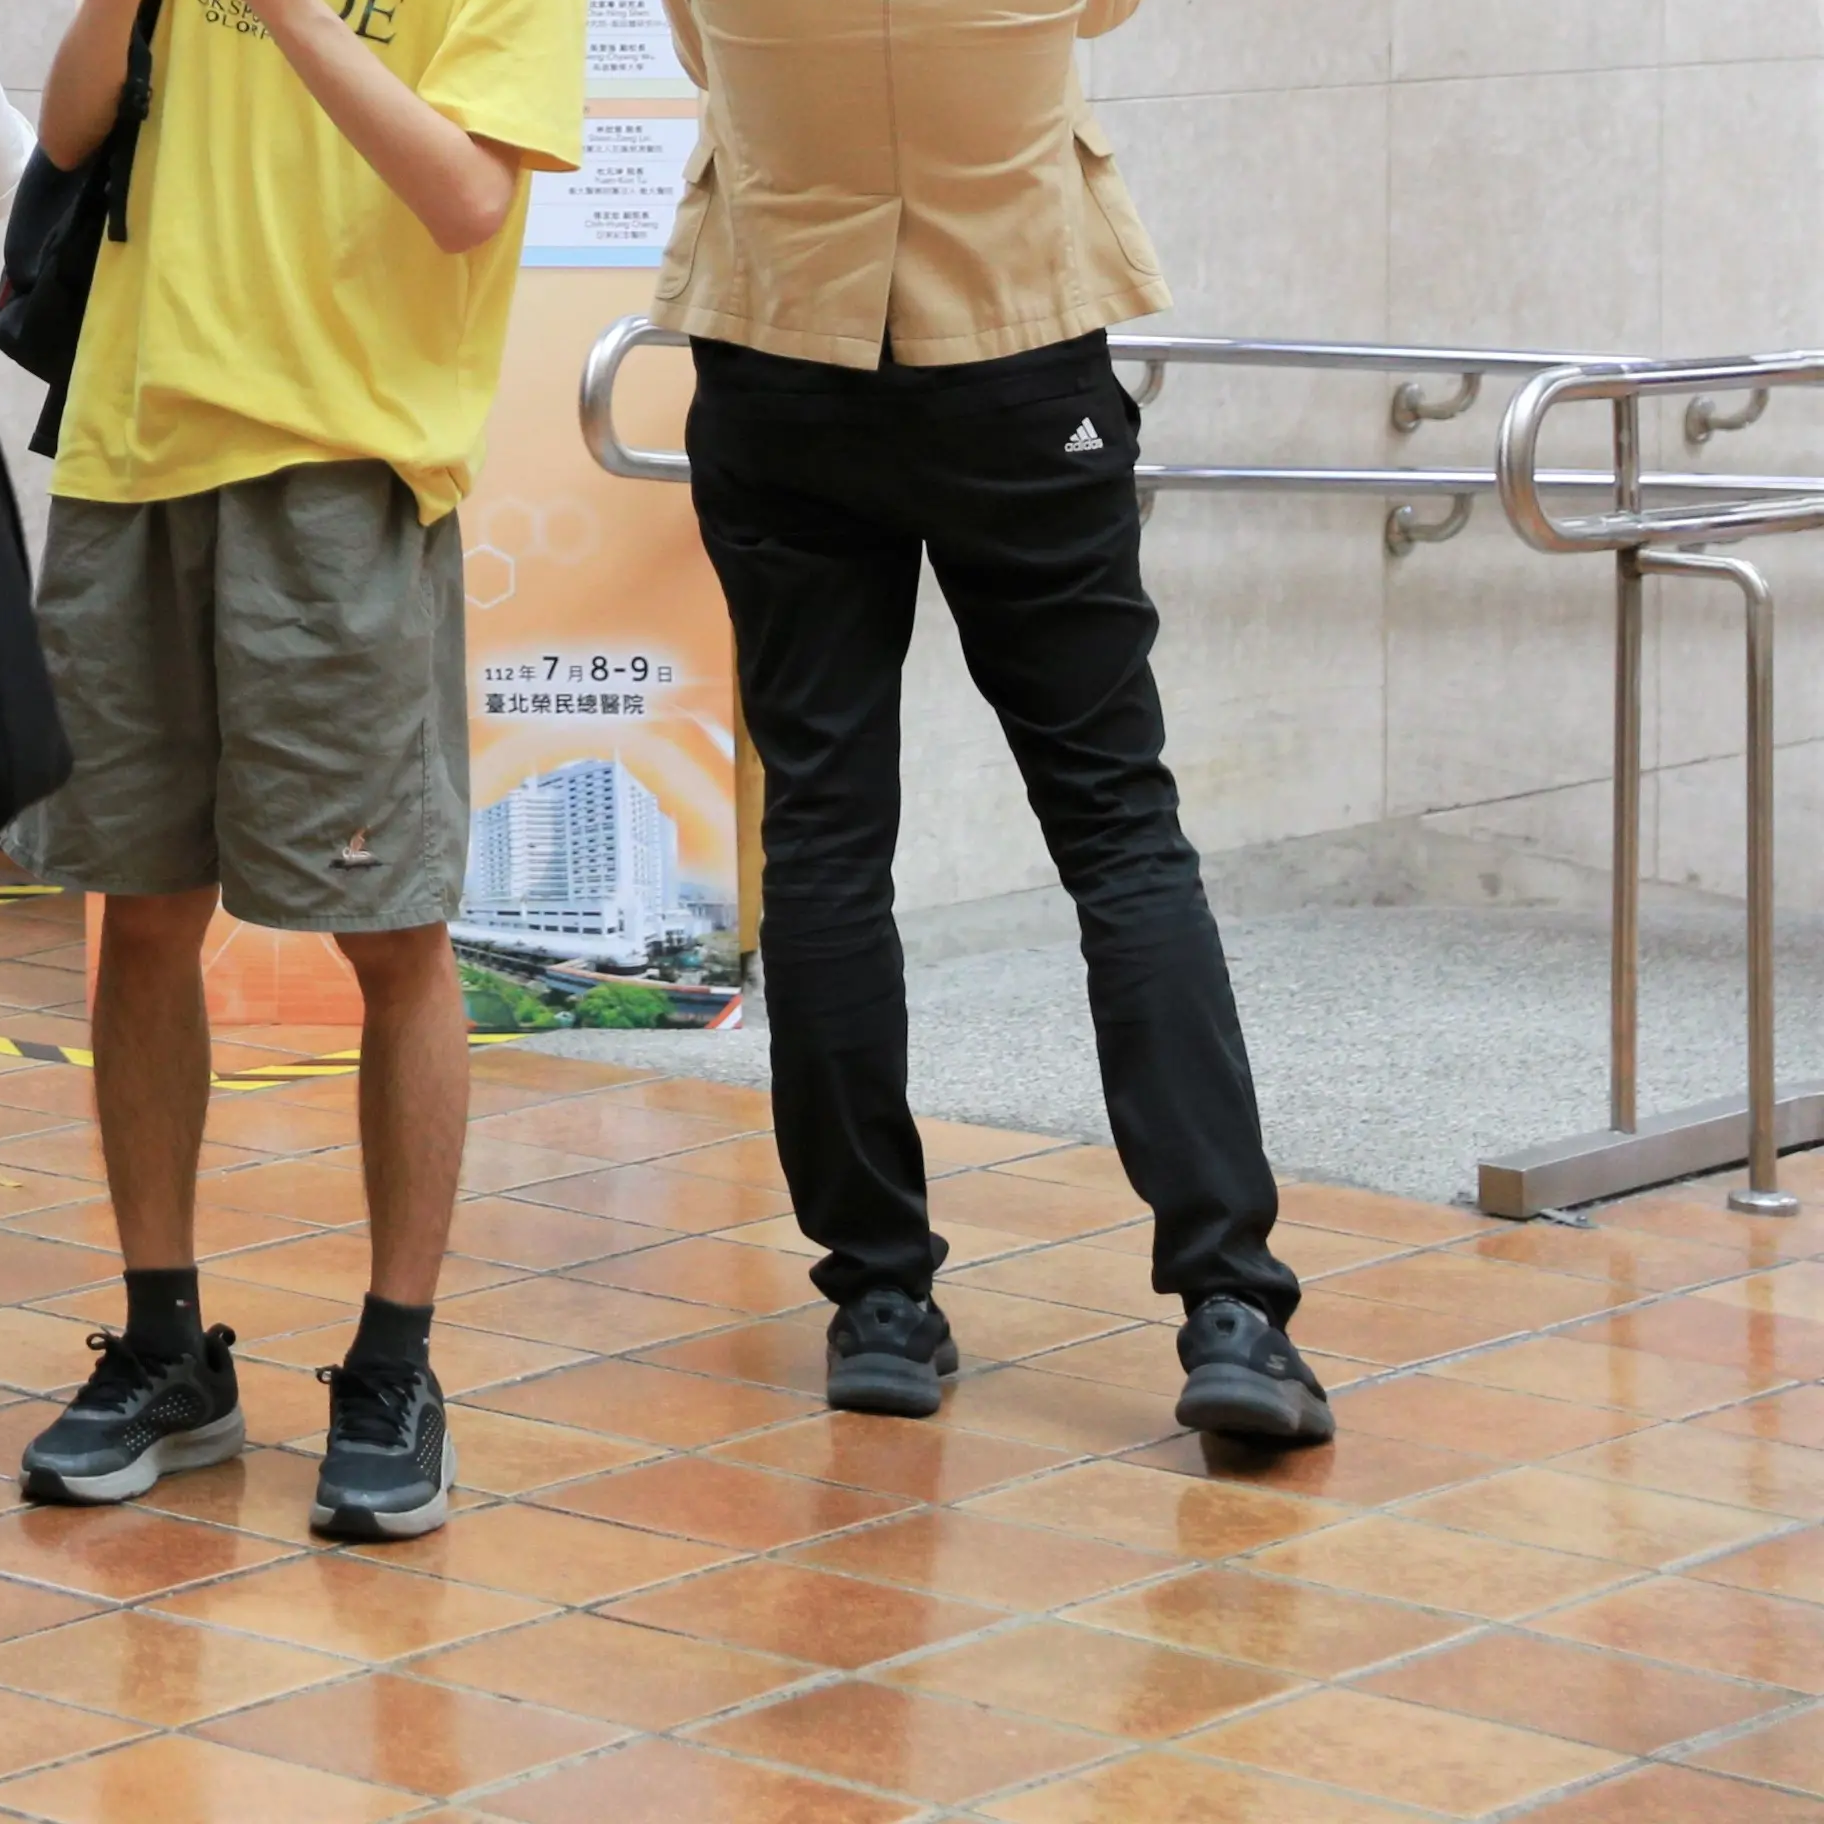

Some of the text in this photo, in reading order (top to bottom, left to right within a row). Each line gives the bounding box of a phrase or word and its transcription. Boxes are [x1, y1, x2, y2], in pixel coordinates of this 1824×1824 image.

[485, 692, 645, 715] 臺北榮民總醫院
